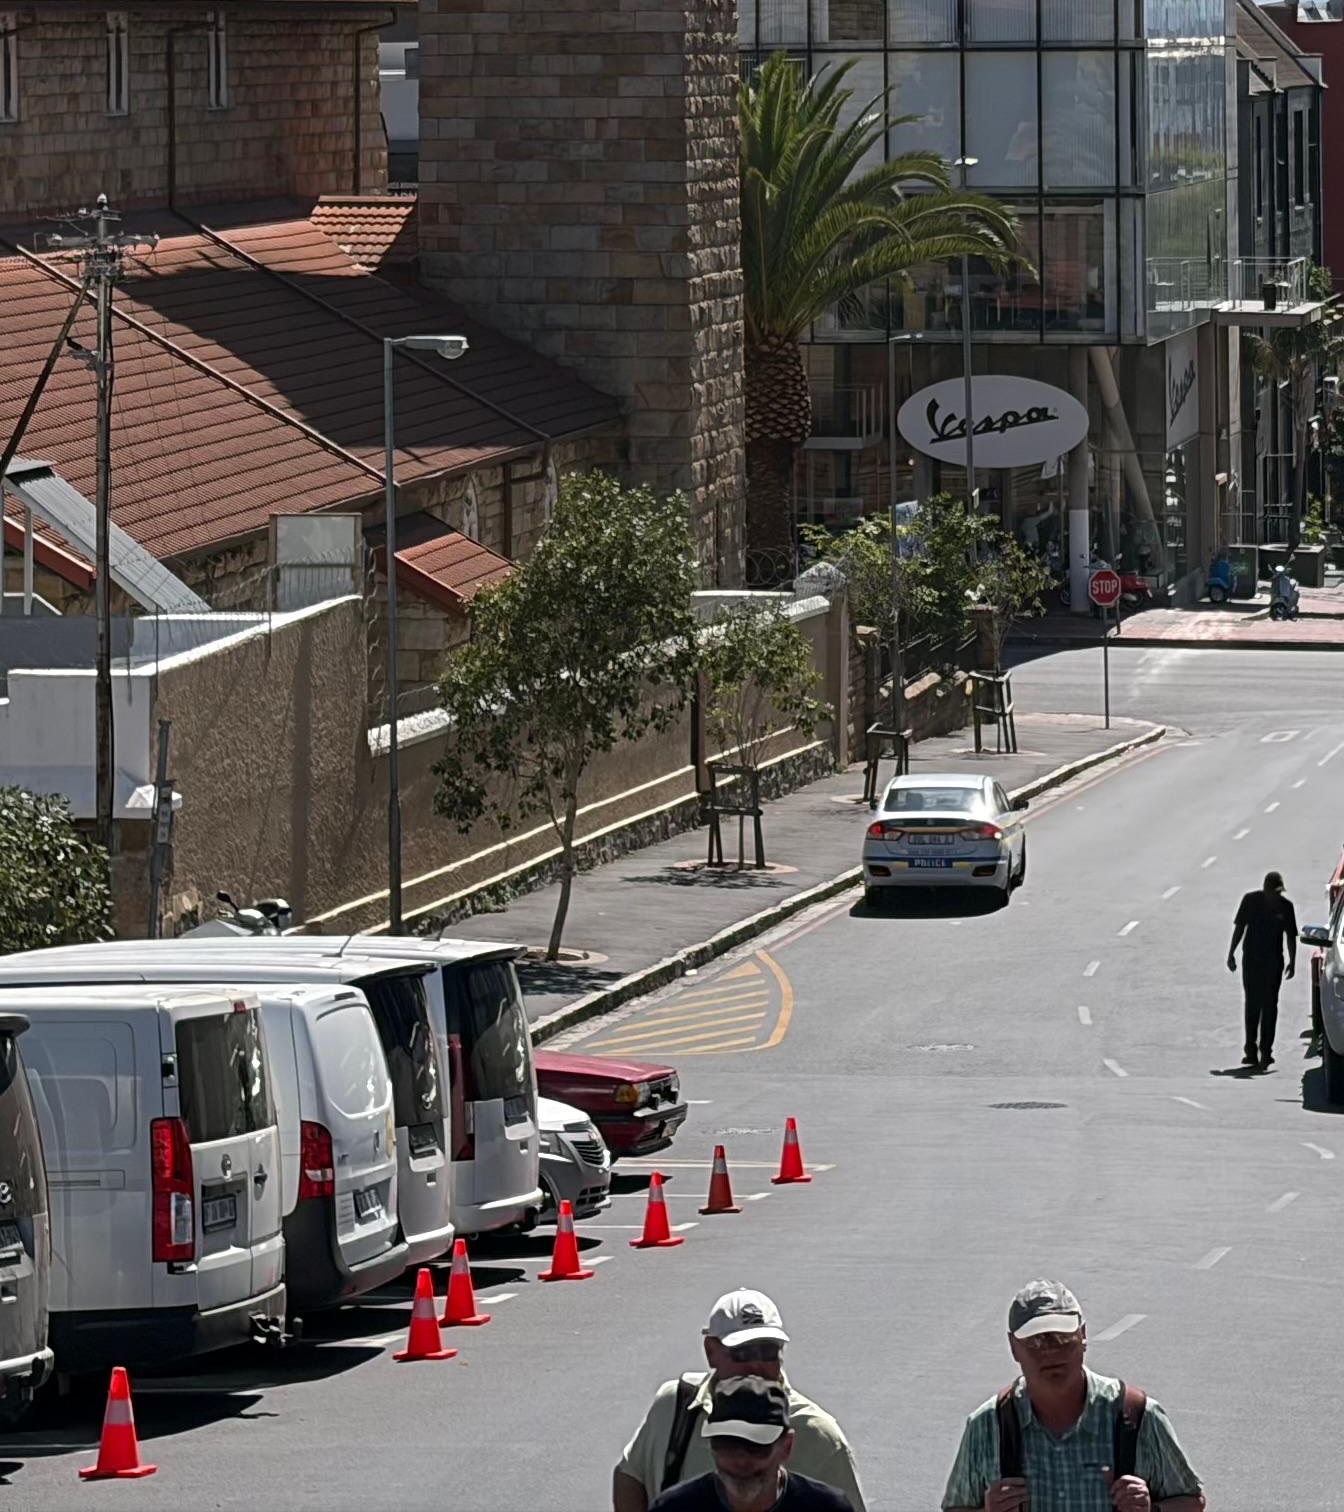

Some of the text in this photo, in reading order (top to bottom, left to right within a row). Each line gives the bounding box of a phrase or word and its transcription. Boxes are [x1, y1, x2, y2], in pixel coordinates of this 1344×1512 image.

[1168, 355, 1196, 428] Vespa
[925, 397, 1059, 445] Vespa
[1091, 579, 1118, 596] STOP
